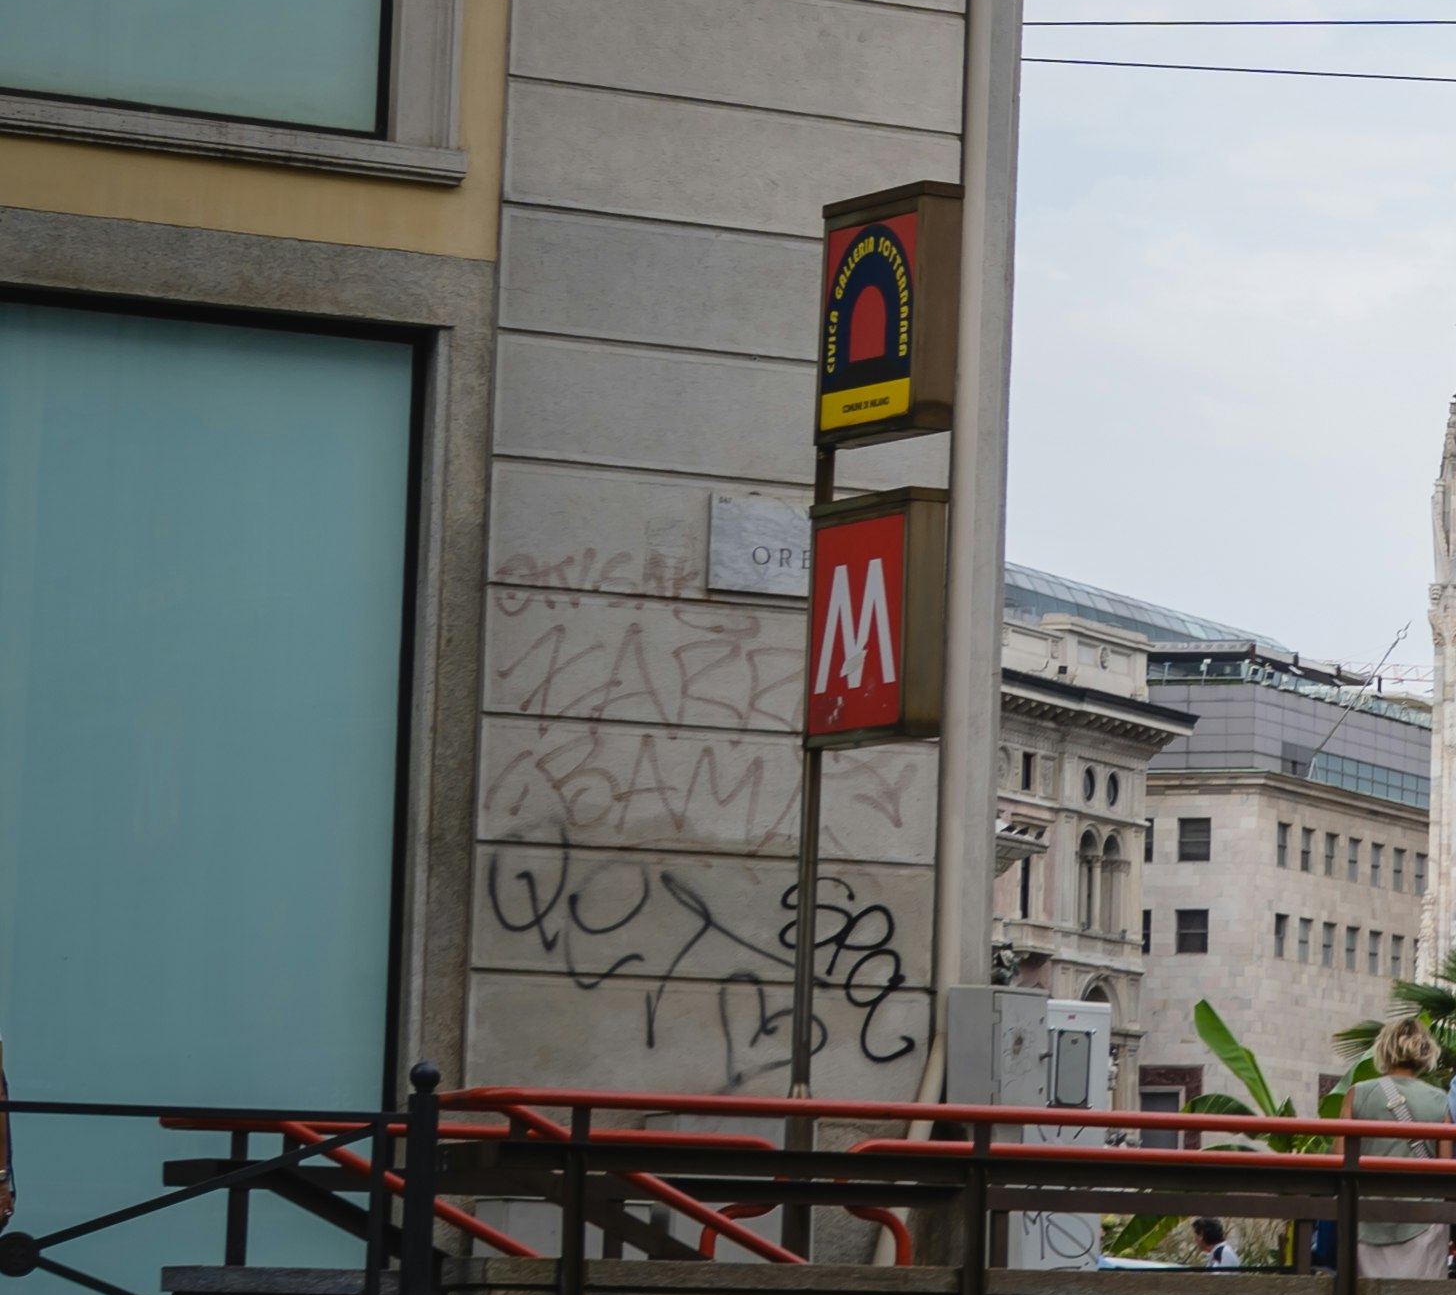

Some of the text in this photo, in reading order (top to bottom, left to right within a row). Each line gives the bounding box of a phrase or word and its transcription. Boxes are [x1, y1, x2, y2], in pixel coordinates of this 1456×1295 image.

[827, 236, 909, 373] CIVICA GALLERIA SOTTERRANEA
[814, 558, 896, 695] M
